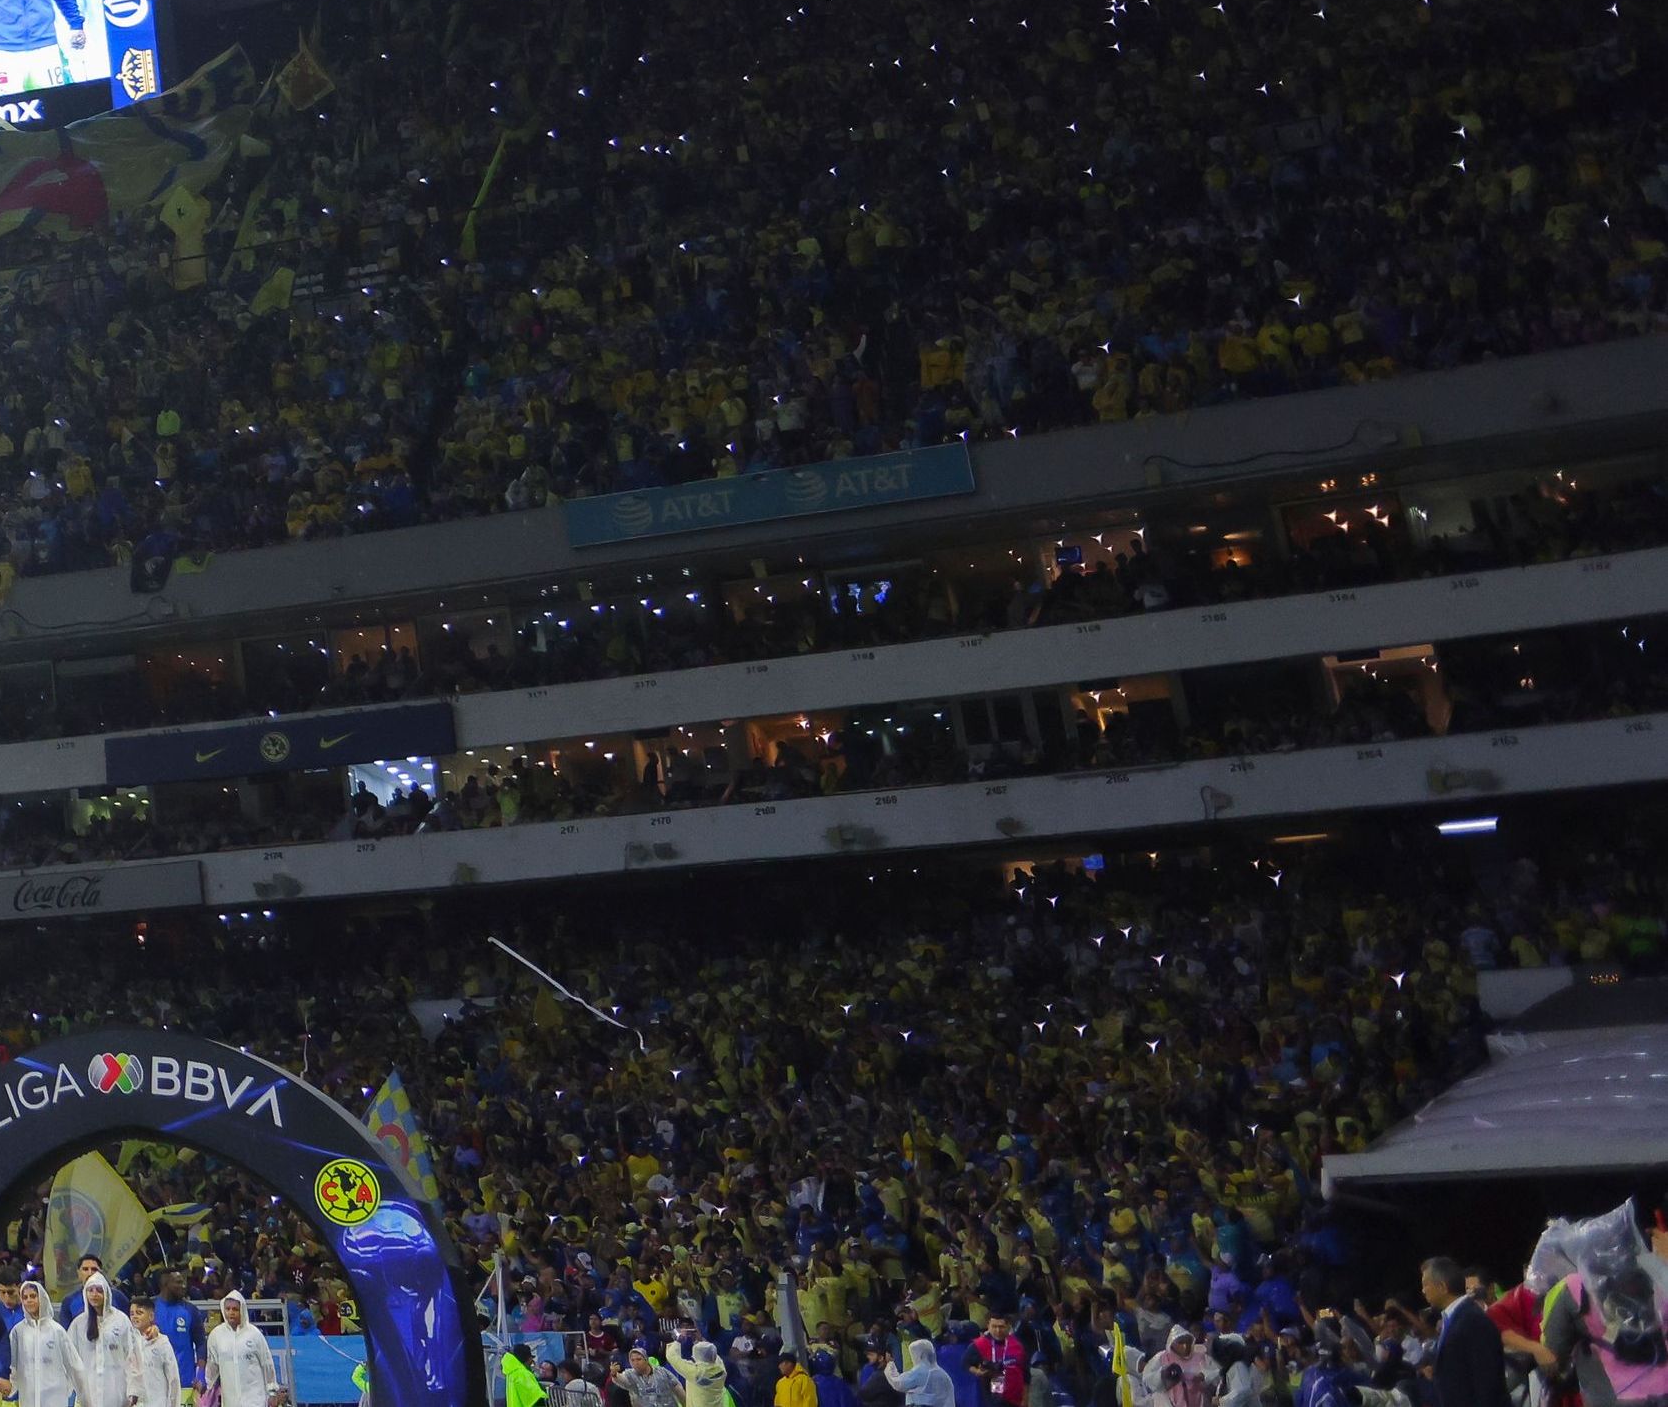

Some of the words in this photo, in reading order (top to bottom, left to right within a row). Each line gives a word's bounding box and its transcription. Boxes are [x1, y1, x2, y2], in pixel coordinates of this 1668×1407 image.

[836, 464, 912, 497] AT&T
[662, 489, 733, 522] AT&T
[14, 876, 103, 911] Coca-Cola
[152, 1056, 282, 1128] BBVA
